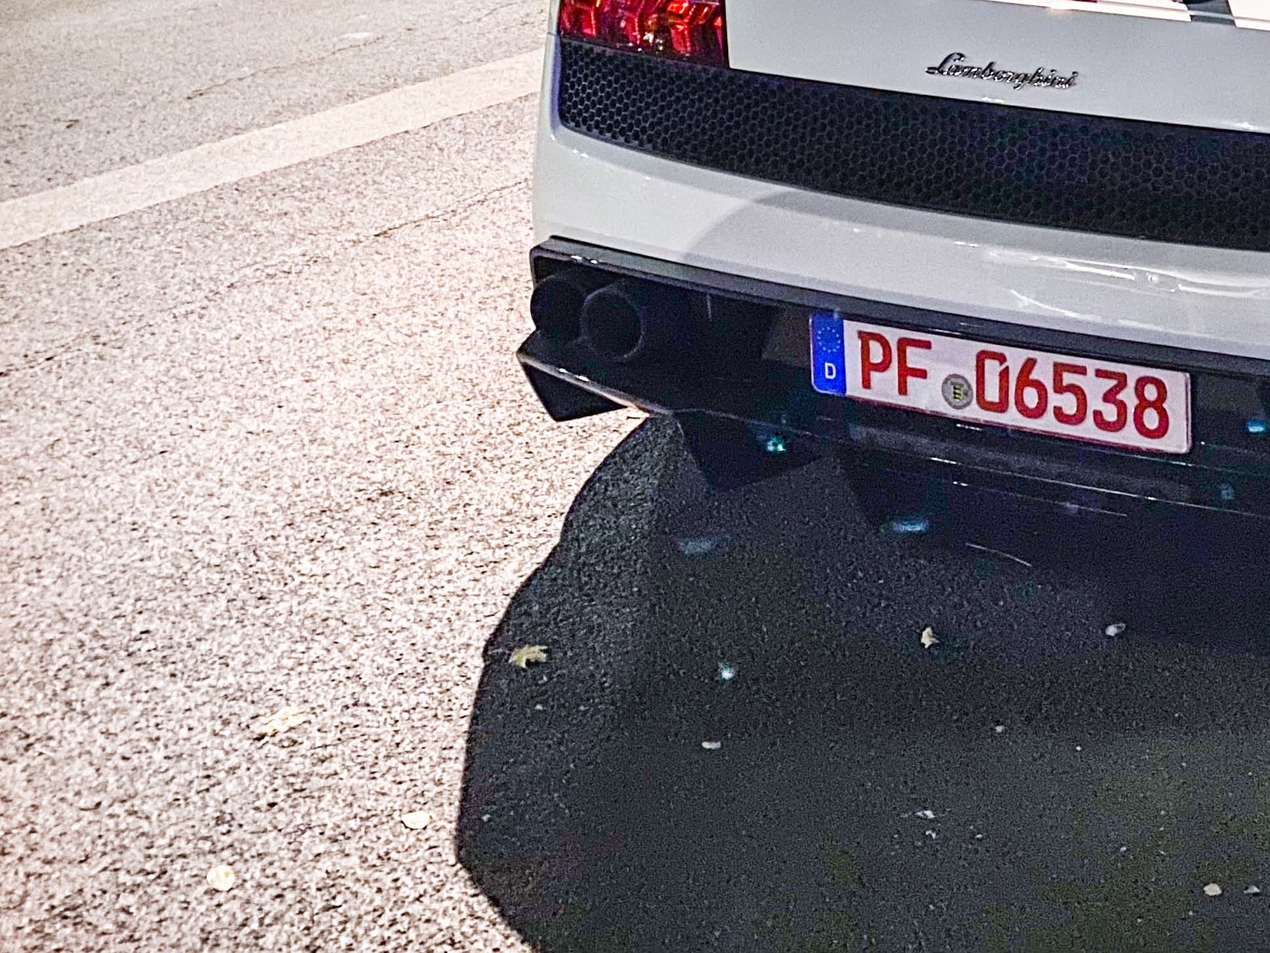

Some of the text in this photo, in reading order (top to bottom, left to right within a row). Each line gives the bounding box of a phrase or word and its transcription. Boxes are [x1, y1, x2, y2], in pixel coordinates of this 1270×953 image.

[925, 51, 1080, 90] Lamborghini
[824, 329, 1170, 440] D PF 06538
